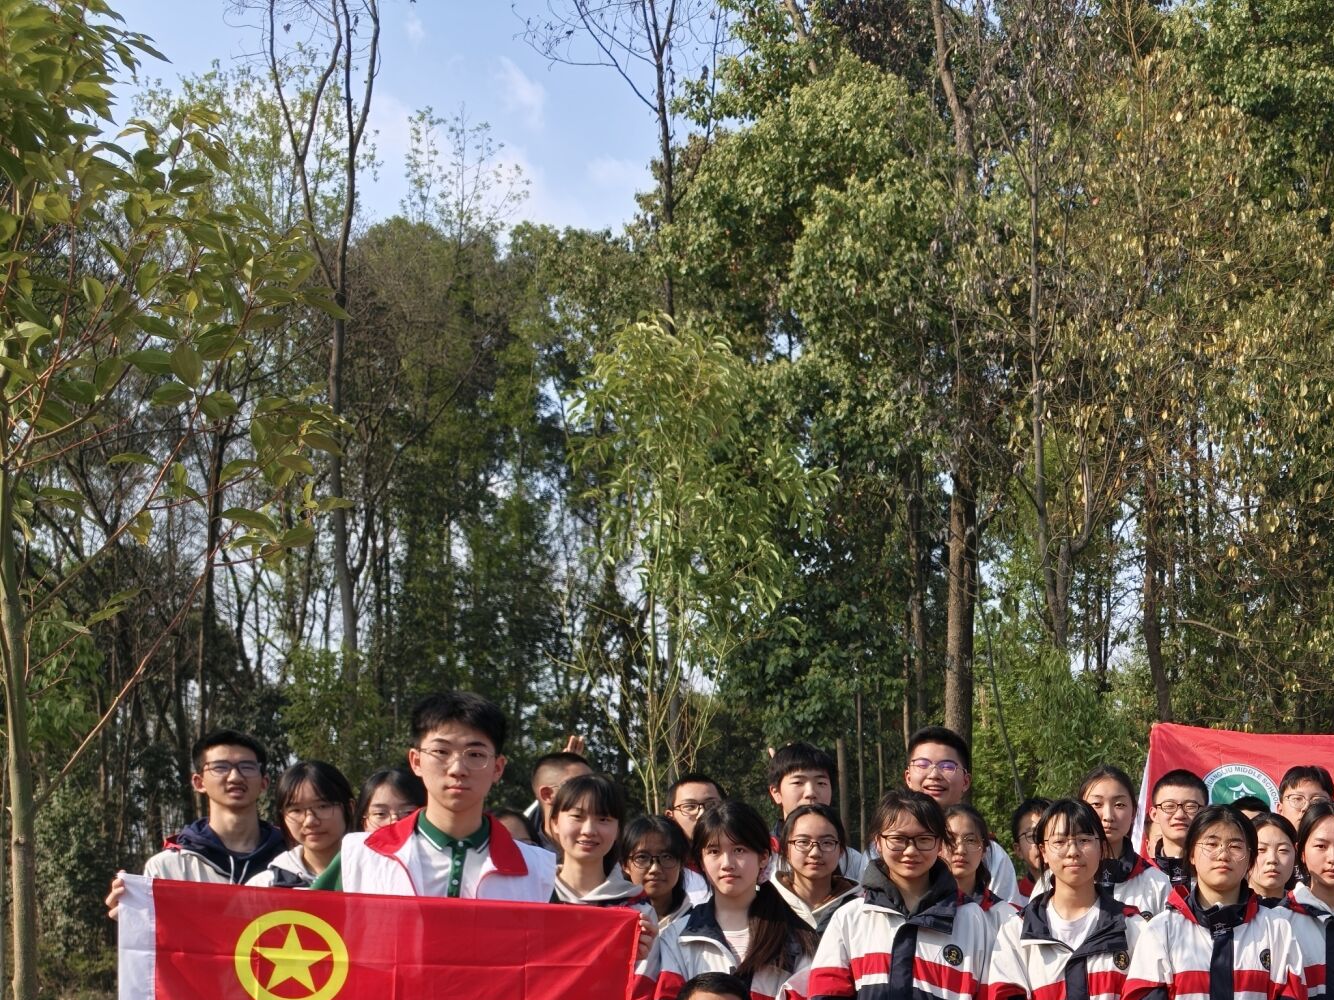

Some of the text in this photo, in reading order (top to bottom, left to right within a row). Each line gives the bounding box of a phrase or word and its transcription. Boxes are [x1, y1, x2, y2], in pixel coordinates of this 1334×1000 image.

[1206, 766, 1280, 805] HUANGLIU MIDDLE SCHOOL
